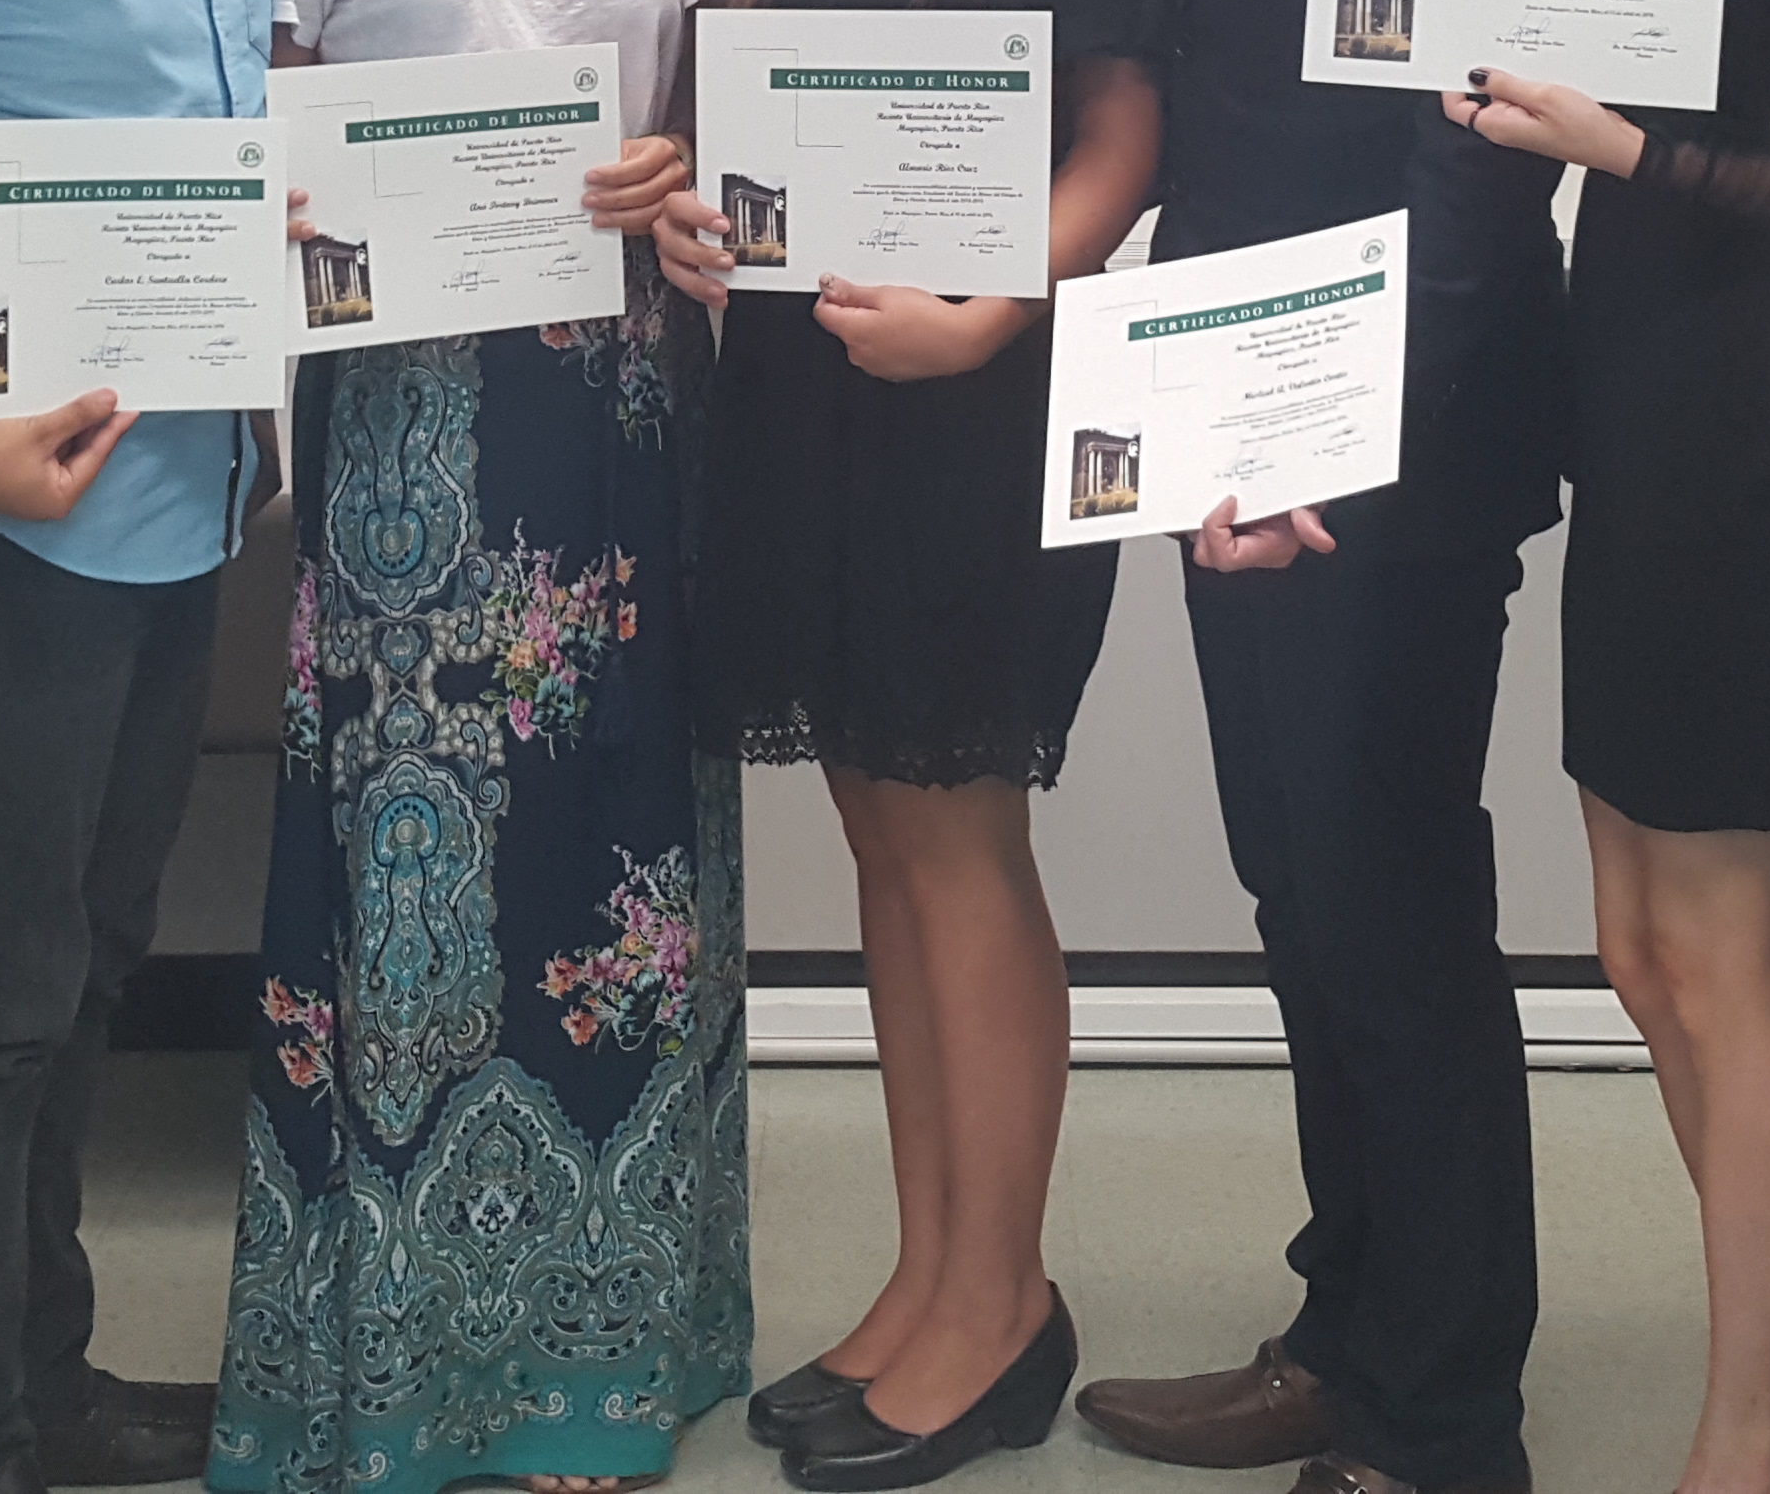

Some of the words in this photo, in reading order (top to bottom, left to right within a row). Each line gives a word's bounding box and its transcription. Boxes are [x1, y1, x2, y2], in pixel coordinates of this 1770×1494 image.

[786, 72, 904, 86] CERTIFICADO
[914, 76, 934, 87] DE
[946, 74, 1008, 87] HONOR
[362, 118, 478, 138] CERTIFICADO
[488, 115, 507, 126] DE
[518, 109, 578, 123] HONOR
[956, 162, 978, 173] Cruz
[8, 186, 131, 200] CERTIFICADO
[142, 185, 162, 196] DE
[175, 183, 241, 196] HONOR
[468, 202, 487, 212] Ana
[104, 275, 134, 285] Carlos
[1144, 306, 1263, 335] CERTIFICADO
[1273, 299, 1293, 312] DE
[1303, 282, 1364, 306] HONOR
